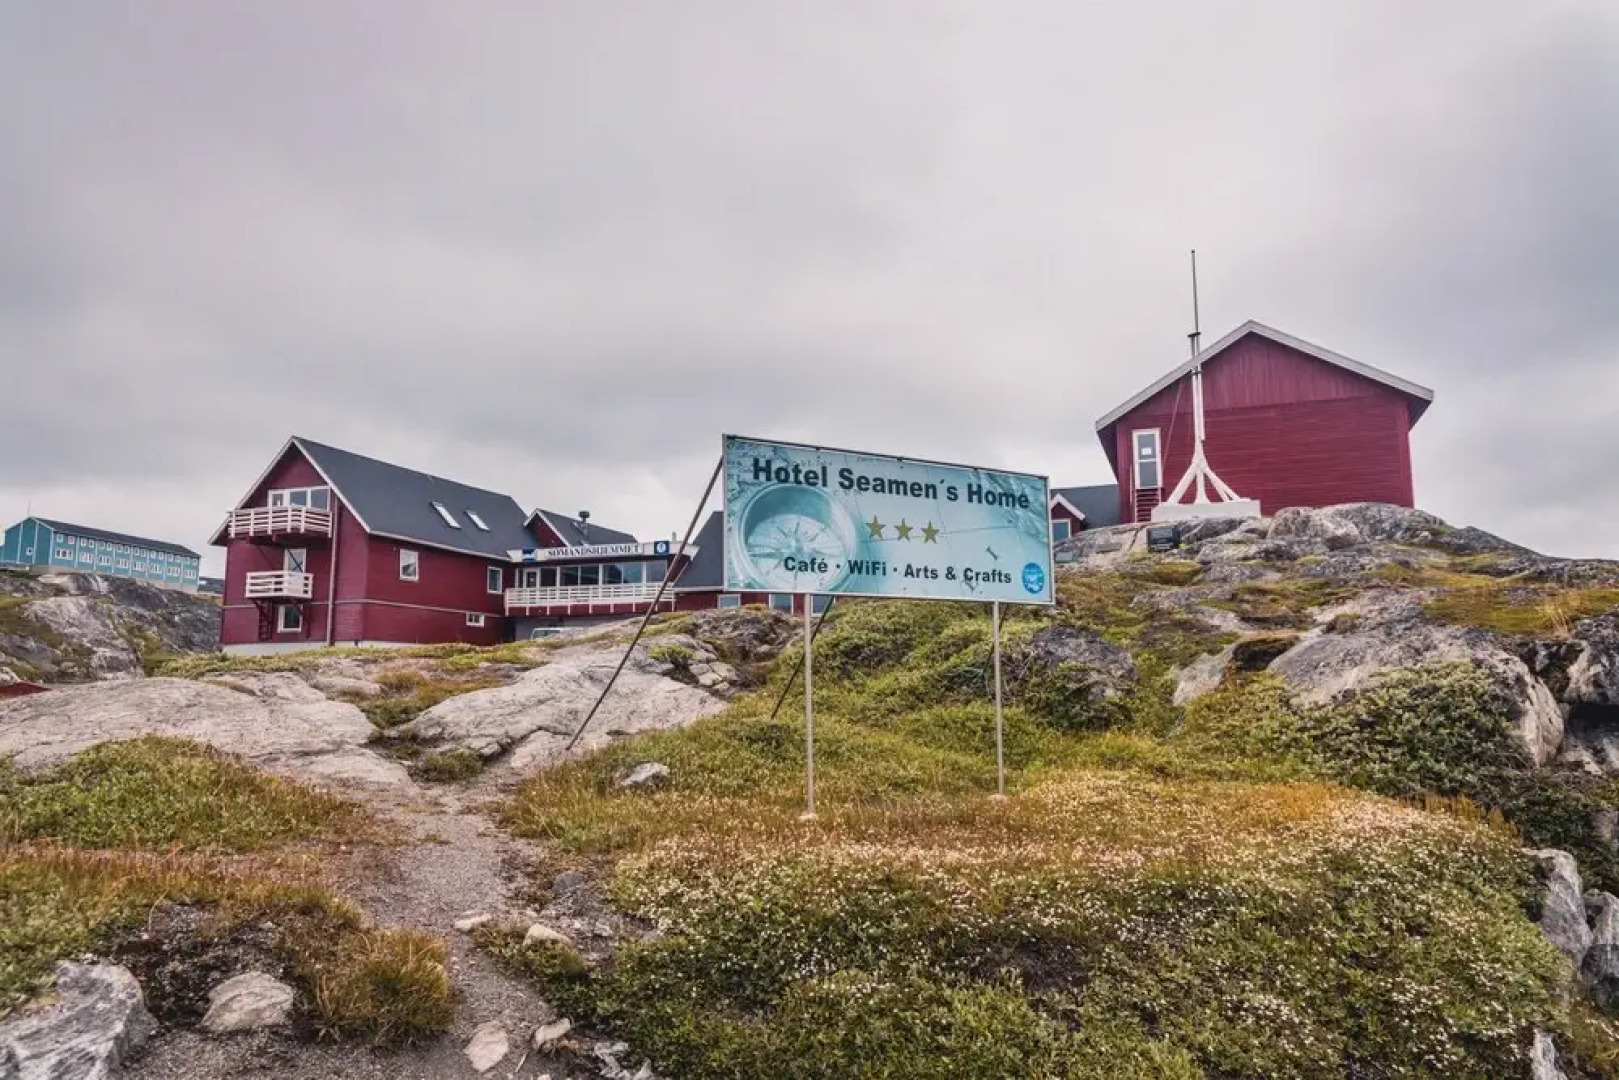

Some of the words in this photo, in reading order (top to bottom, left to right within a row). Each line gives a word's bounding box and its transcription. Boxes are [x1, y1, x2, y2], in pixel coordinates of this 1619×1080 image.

[752, 457, 828, 487] Hotel
[967, 483, 1030, 509] Home
[783, 556, 828, 573] Café
[847, 559, 887, 576] WiFi
[904, 563, 939, 580] Arts
[945, 566, 957, 580] &
[963, 567, 1012, 584] Crafts
